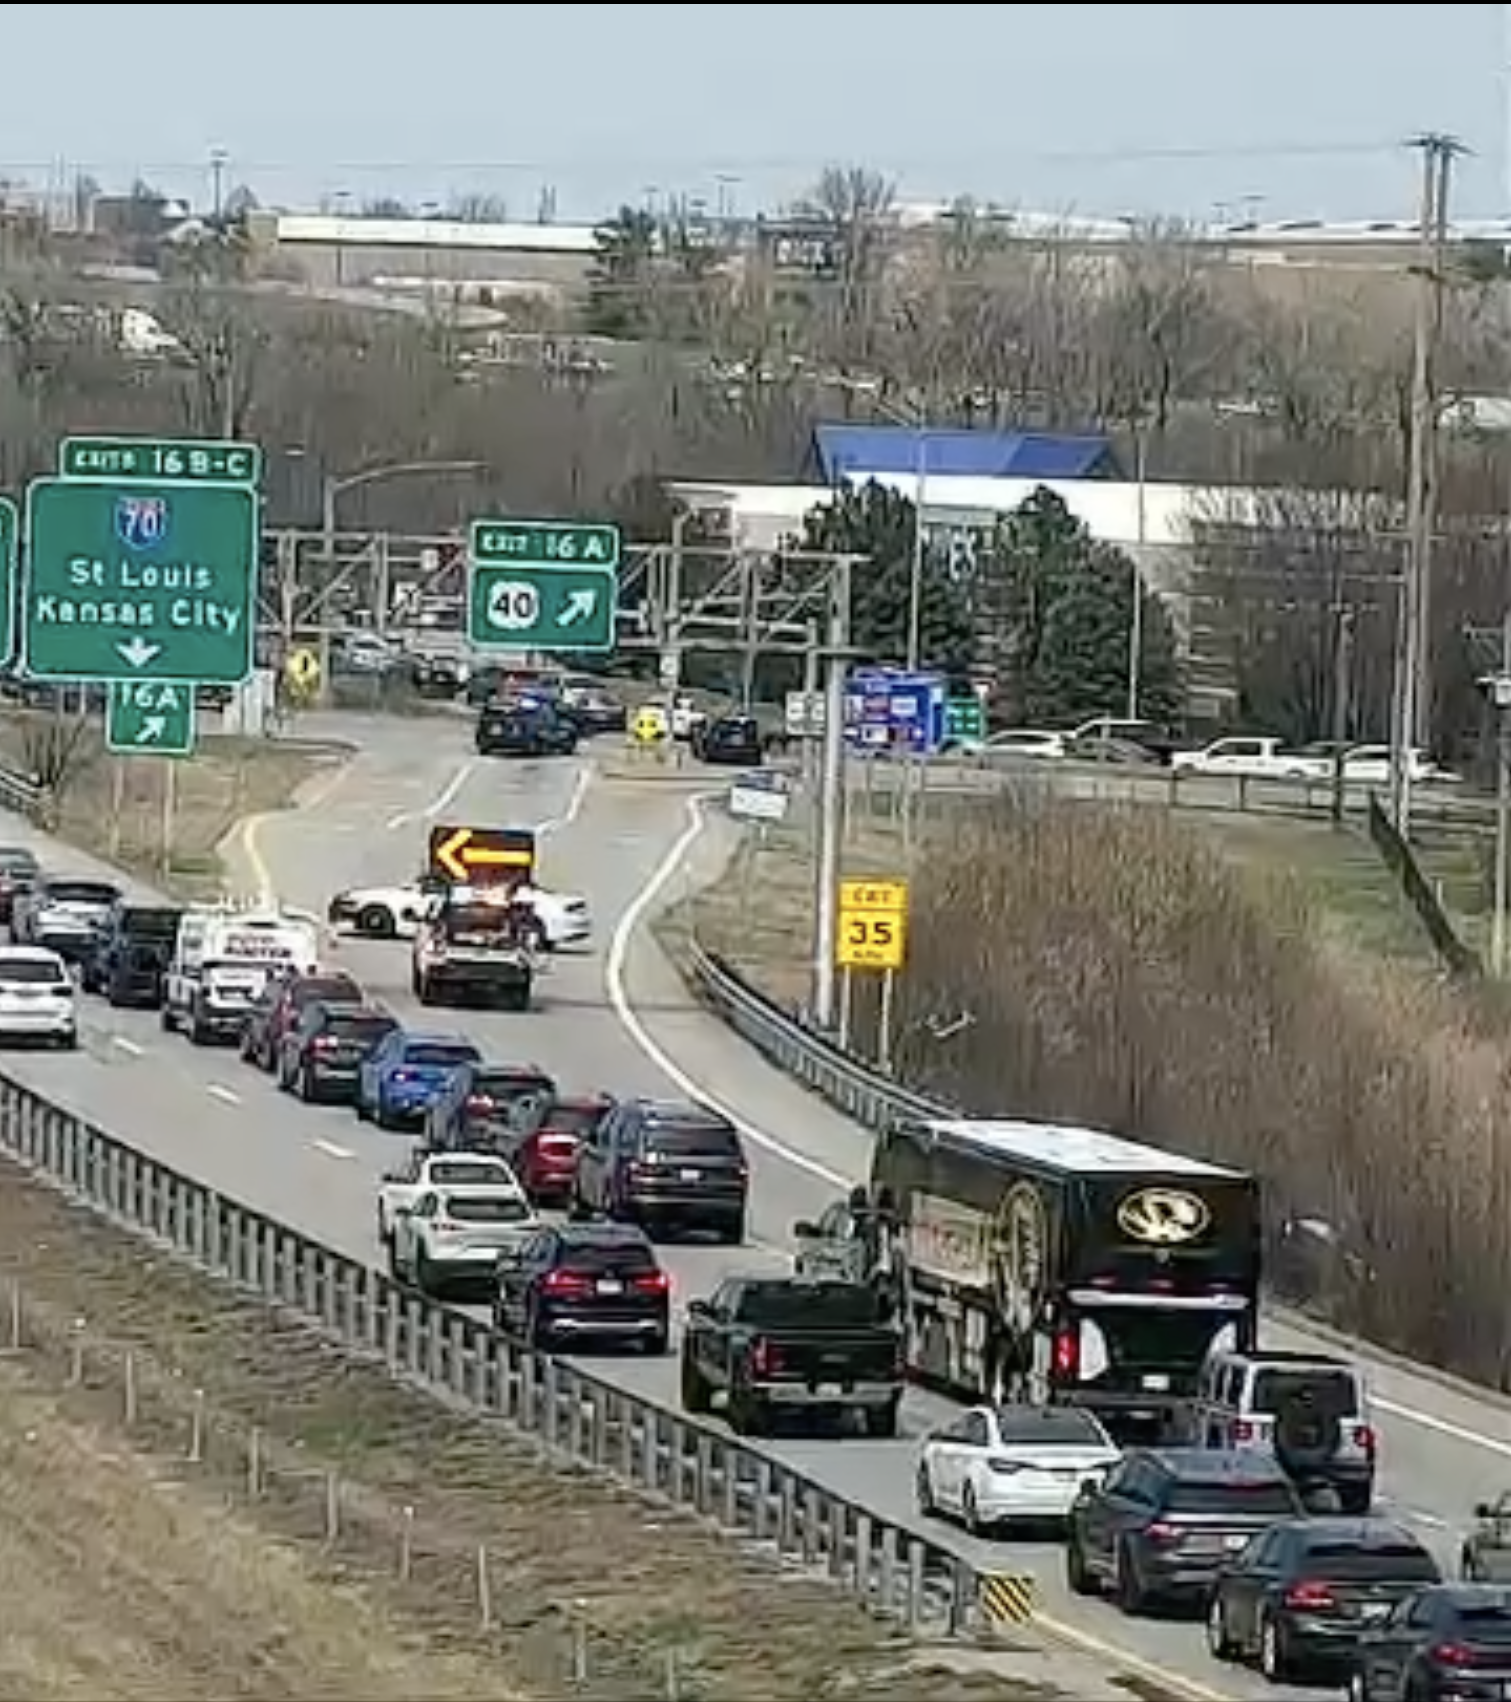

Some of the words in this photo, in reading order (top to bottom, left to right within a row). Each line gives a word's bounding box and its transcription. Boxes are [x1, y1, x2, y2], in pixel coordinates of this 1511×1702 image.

[123, 510, 158, 539] 70
[69, 558, 104, 587] St
[120, 558, 213, 589] Louis
[37, 595, 155, 625] Kansas
[171, 599, 241, 635] City
[493, 591, 535, 619] 40
[121, 684, 179, 711] 16A
[849, 921, 893, 945] 35
